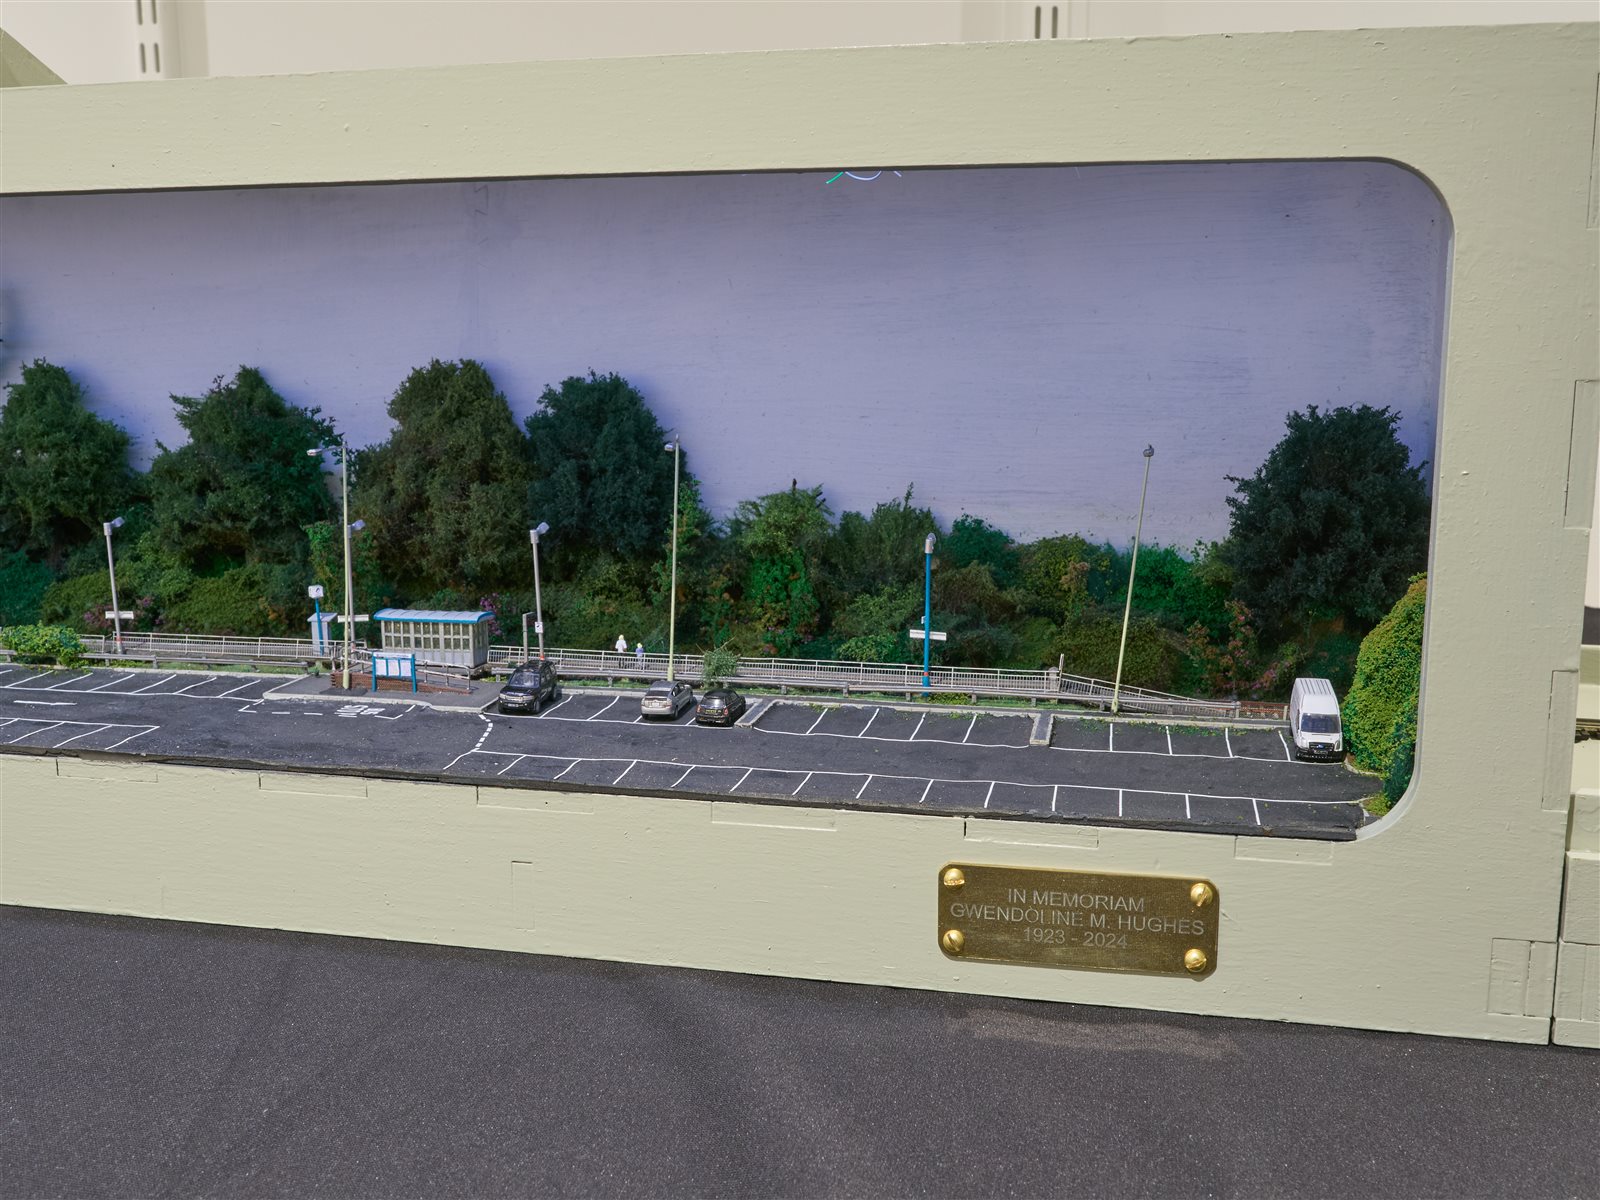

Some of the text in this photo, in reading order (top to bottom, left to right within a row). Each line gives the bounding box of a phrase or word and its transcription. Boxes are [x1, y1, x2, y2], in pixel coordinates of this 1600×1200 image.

[1008, 888, 1145, 912] IN MEMORIAM
[950, 902, 1205, 936] GWENDOLINE M. HUGHES
[1023, 926, 1066, 944] 1923
[1082, 931, 1128, 949] 2024
